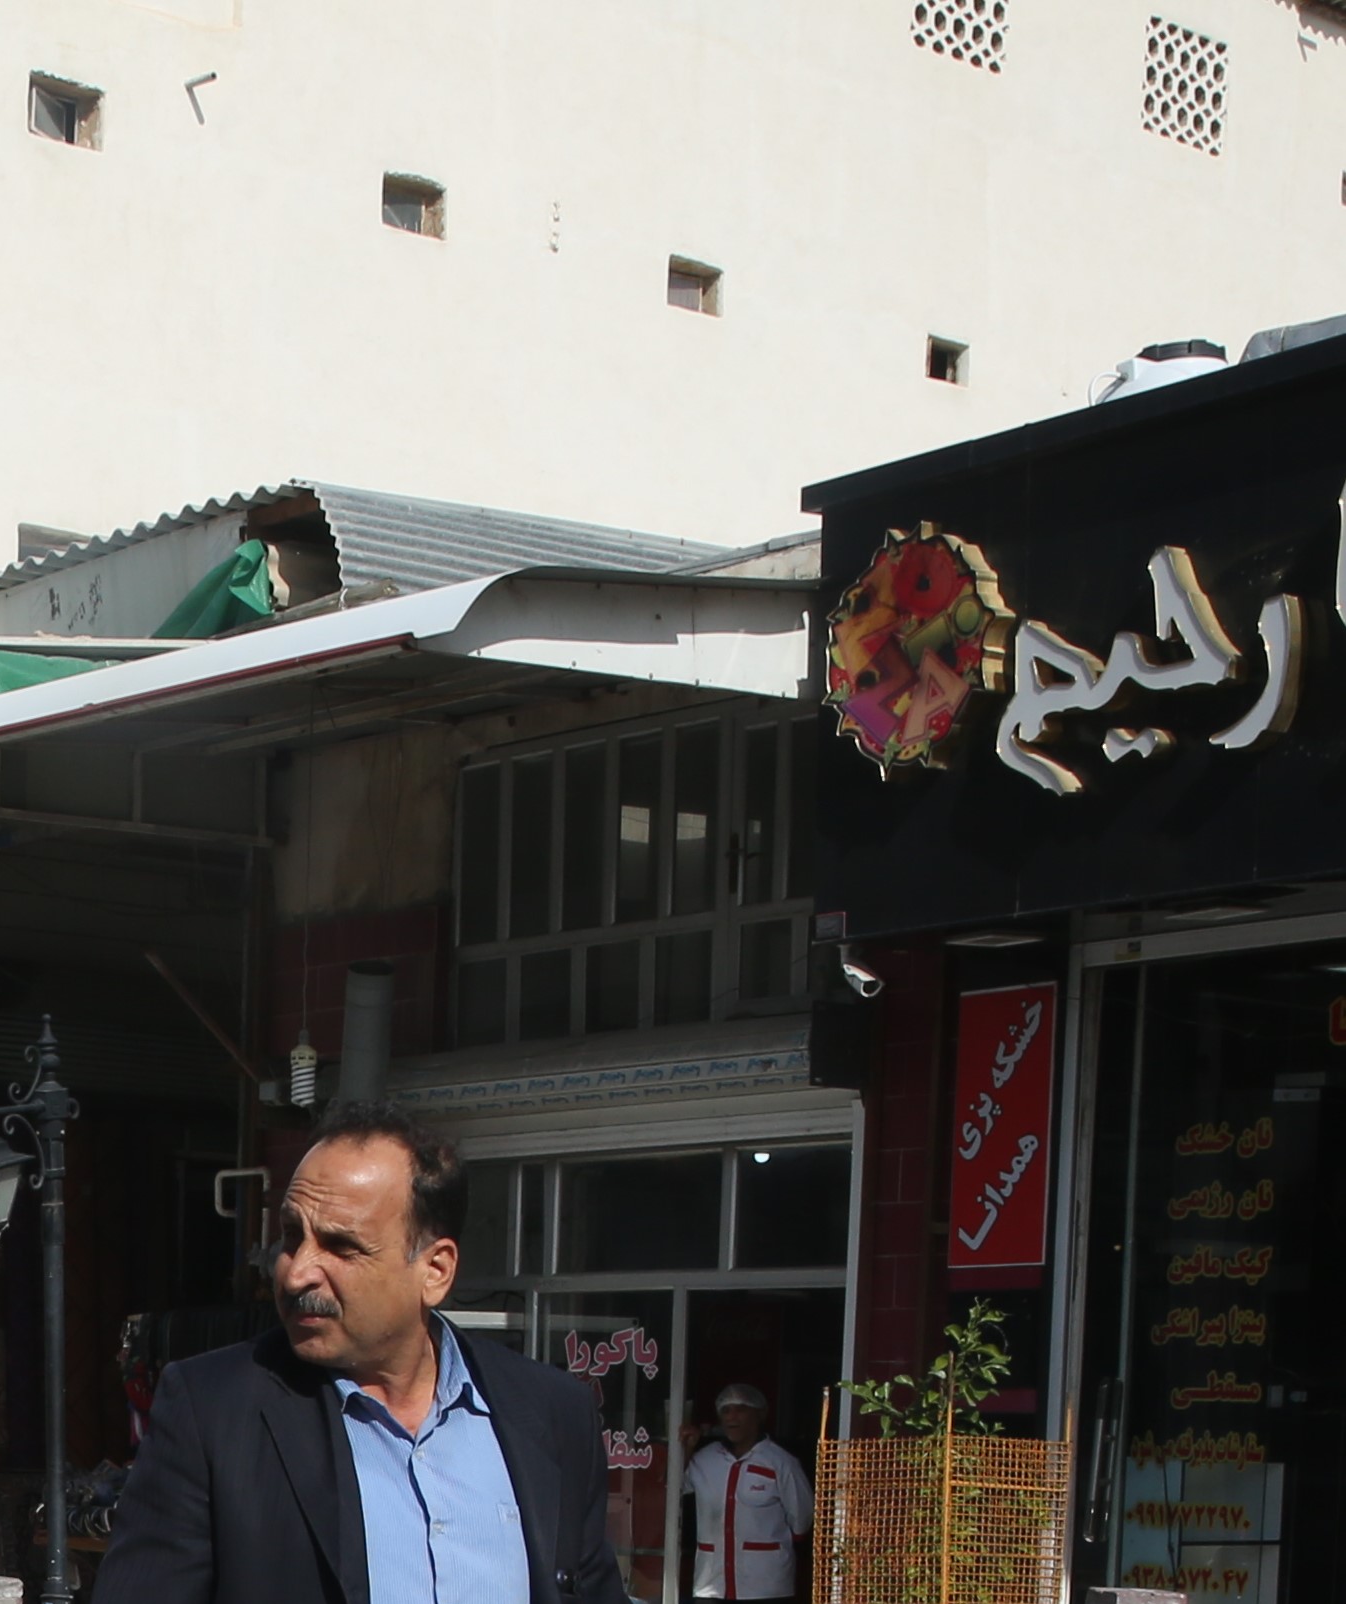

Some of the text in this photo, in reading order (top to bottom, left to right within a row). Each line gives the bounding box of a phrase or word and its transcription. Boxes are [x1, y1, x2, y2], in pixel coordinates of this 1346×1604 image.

[996, 546, 1302, 797] رحیم
[958, 1000, 1043, 1161] خشکه پزی
[1175, 1116, 1274, 1159] نان خشک
[1236, 1178, 1275, 1221] نان
[1166, 1243, 1274, 1286] کیک مافین
[1228, 1304, 1267, 1347] پیتزا
[564, 1326, 658, 1380] پاکورا
